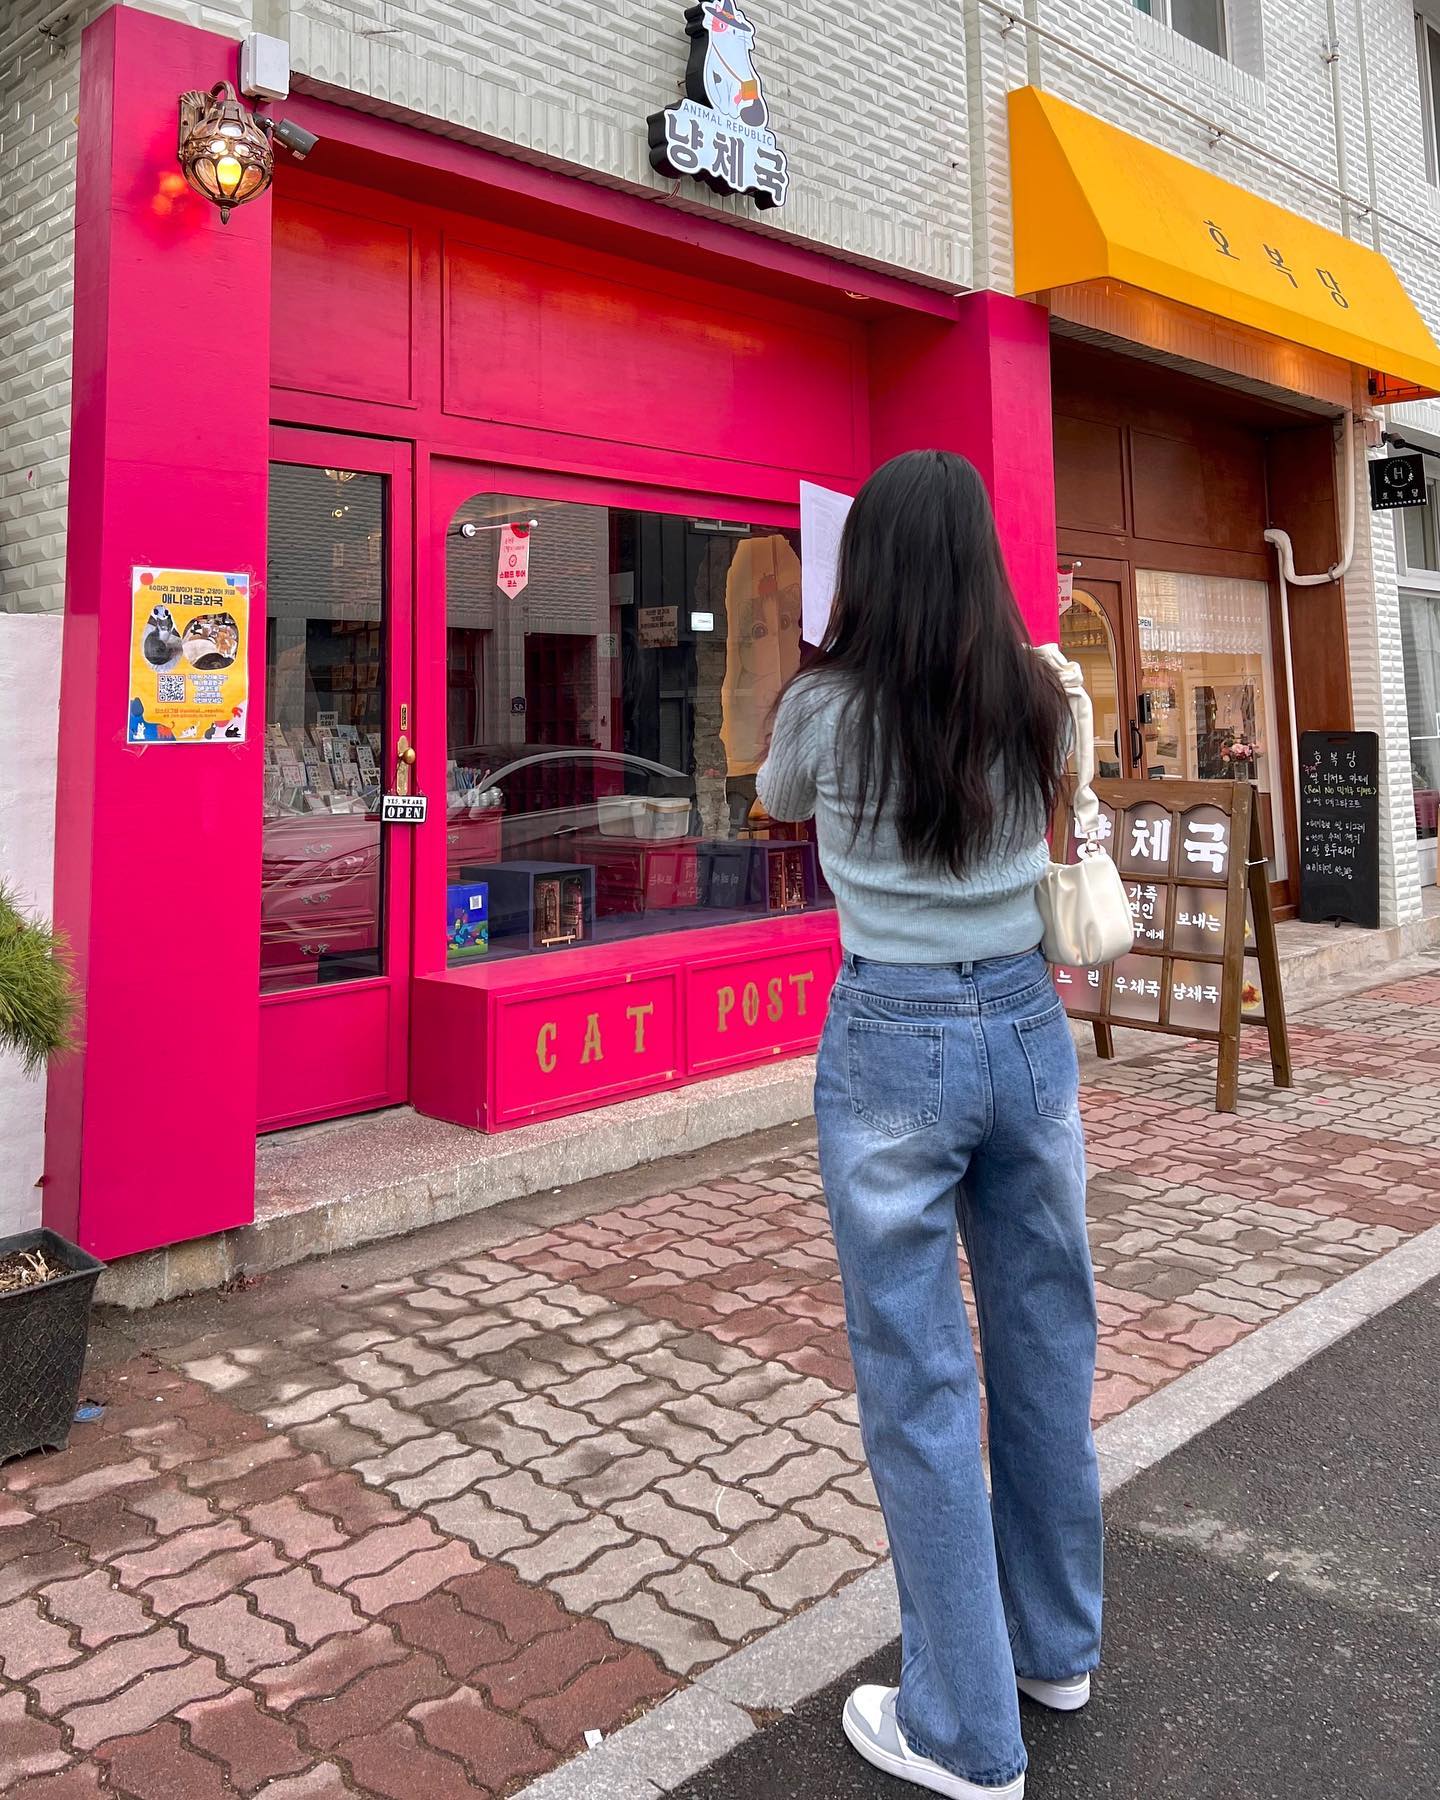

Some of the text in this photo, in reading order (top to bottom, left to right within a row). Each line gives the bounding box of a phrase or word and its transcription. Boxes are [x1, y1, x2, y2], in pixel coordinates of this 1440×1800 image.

[682, 102, 773, 146] ANIMAL REPUBLIC
[668, 113, 785, 201] 냥체국
[1203, 220, 1349, 309] 호복당
[507, 580, 517, 588] 코스
[162, 593, 223, 607] 애니멀공화국
[388, 806, 422, 818] OPEN
[1324, 843, 1356, 858] 호두파이
[1129, 884, 1158, 902] 가족
[1133, 923, 1164, 940] 구에게
[1176, 912, 1222, 932] 보내는
[1114, 976, 1161, 998] 우체국
[1173, 983, 1220, 1004] 냥체국
[536, 970, 814, 1073] CAT POST
